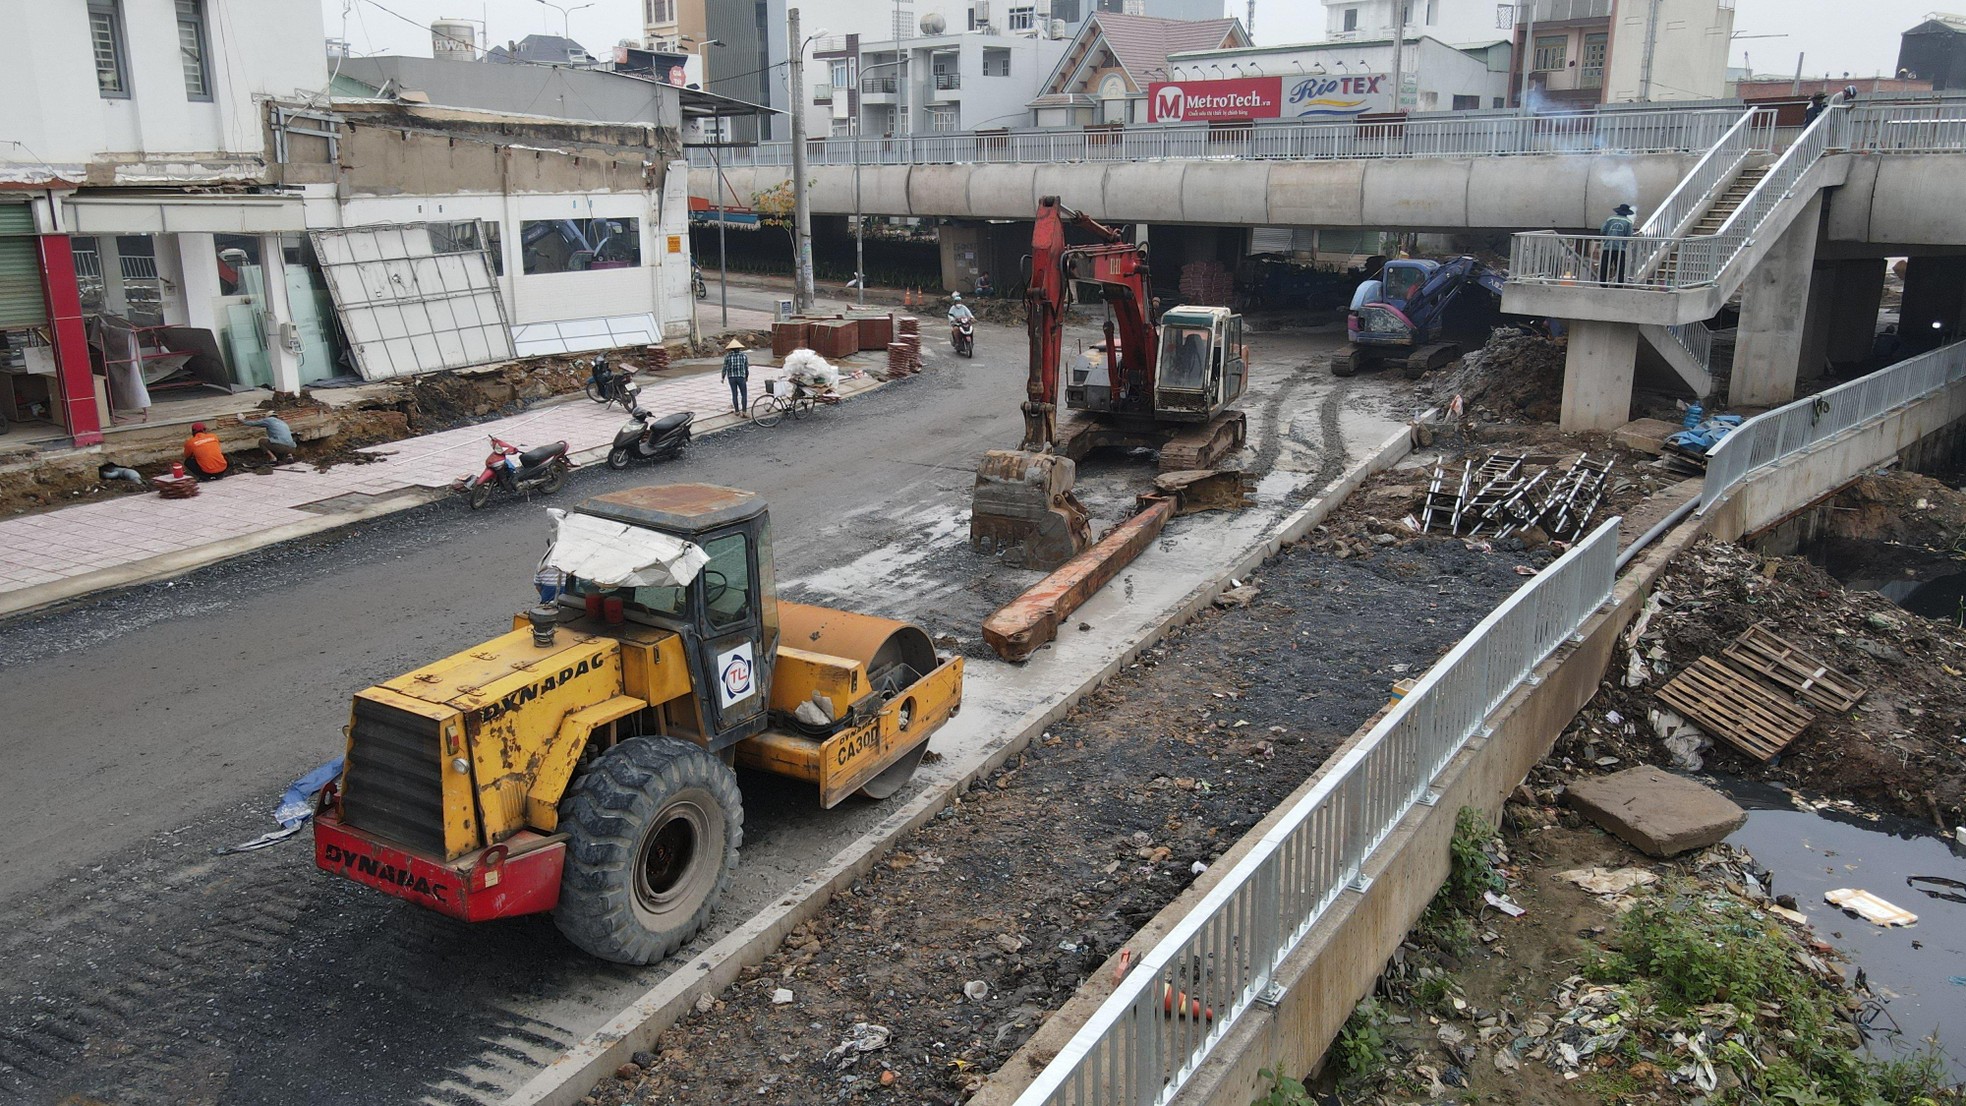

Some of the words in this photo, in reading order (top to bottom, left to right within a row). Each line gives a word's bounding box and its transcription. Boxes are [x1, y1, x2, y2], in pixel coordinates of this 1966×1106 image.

[1157, 94, 1182, 119] M
[483, 652, 604, 723] DYNAPAC
[325, 844, 448, 902] DYNAPAC
